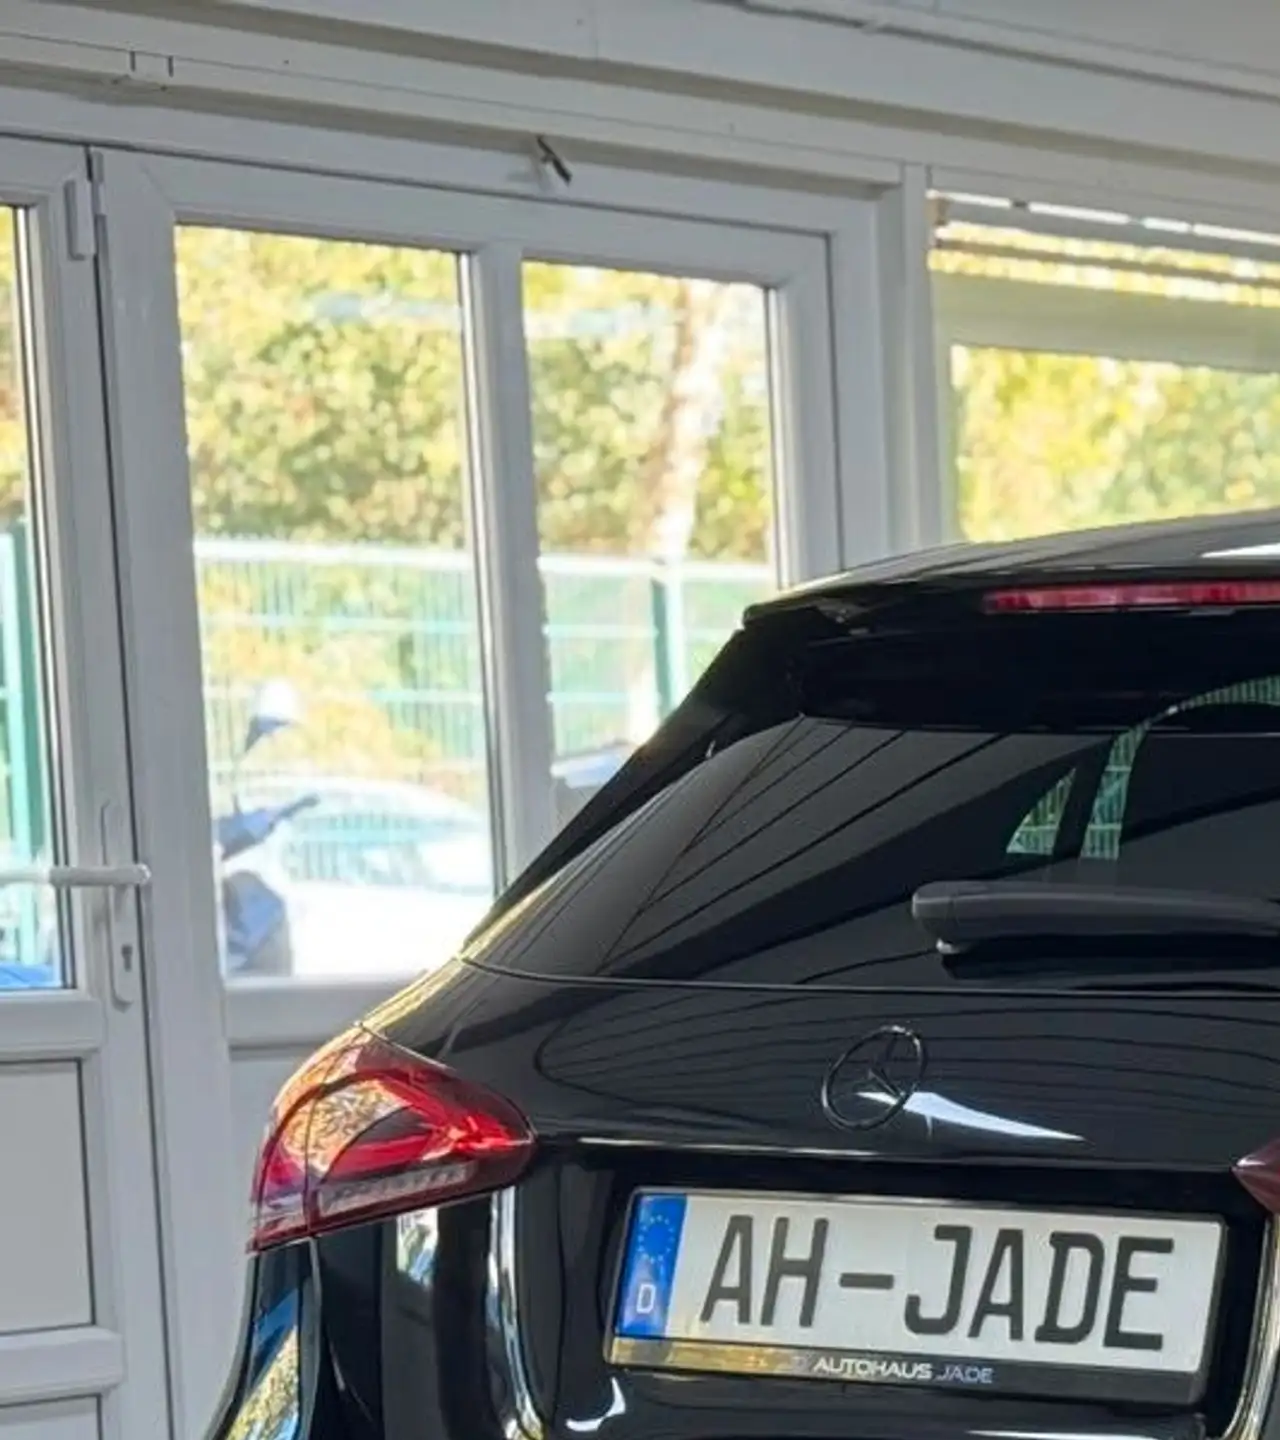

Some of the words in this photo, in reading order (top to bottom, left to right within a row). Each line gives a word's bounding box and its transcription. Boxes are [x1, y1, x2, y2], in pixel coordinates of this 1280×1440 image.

[699, 1214, 1175, 1351] AH-JADE
[636, 1283, 655, 1315] D
[813, 1356, 933, 1380] AUTOHAUS
[936, 1365, 994, 1384] JADE
